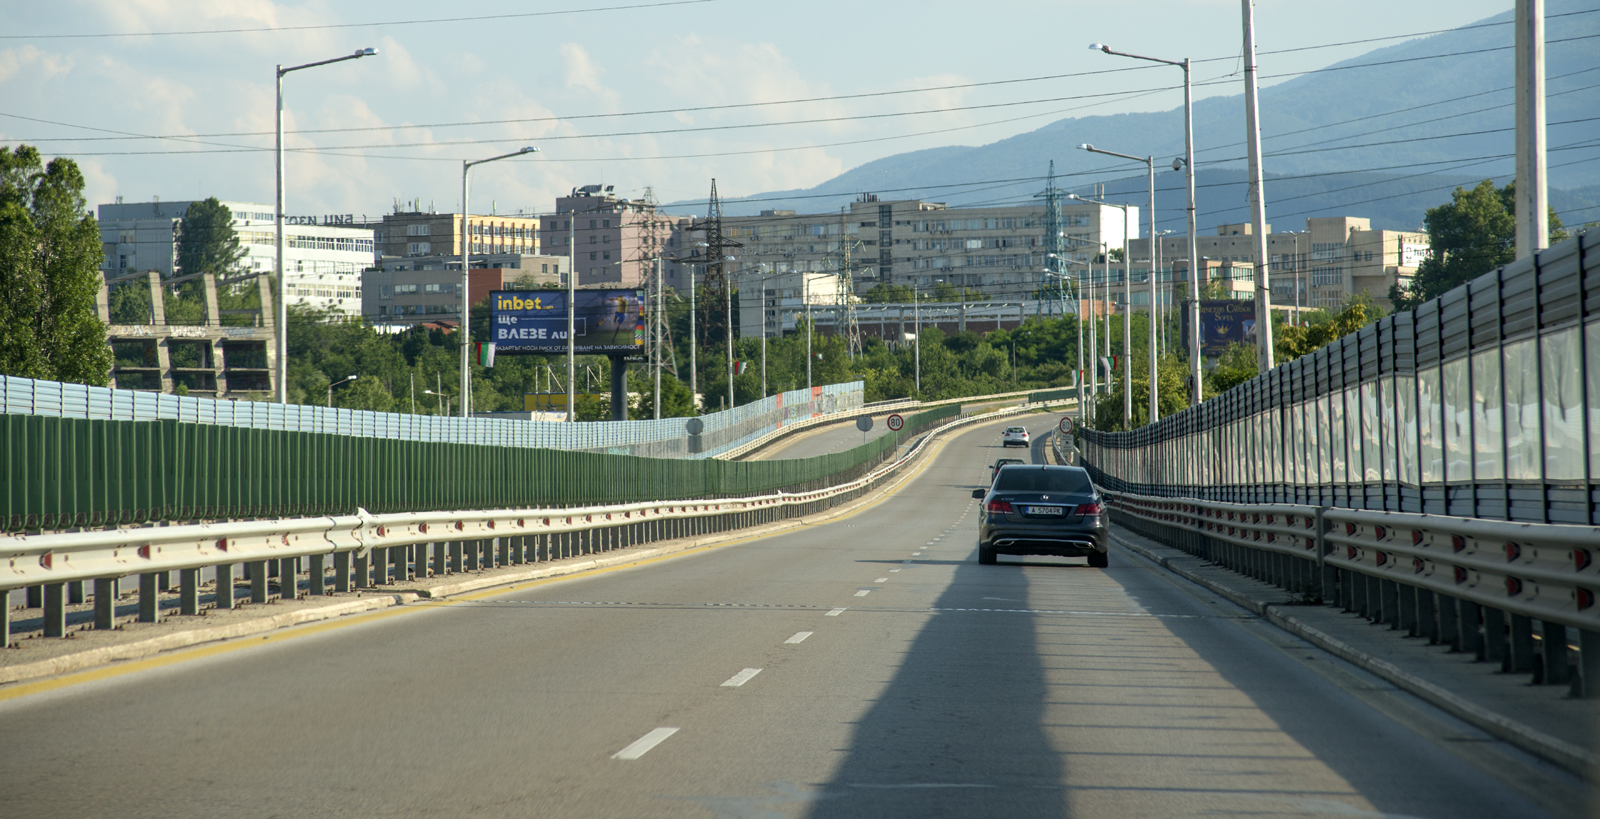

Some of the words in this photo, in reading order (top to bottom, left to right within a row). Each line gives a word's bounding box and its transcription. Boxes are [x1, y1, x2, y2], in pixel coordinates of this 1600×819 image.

[498, 315, 518, 326] Ще
[498, 328, 547, 340] ВЛЕЗЕ
[890, 418, 900, 427] 80
[1062, 421, 1070, 429] 80
